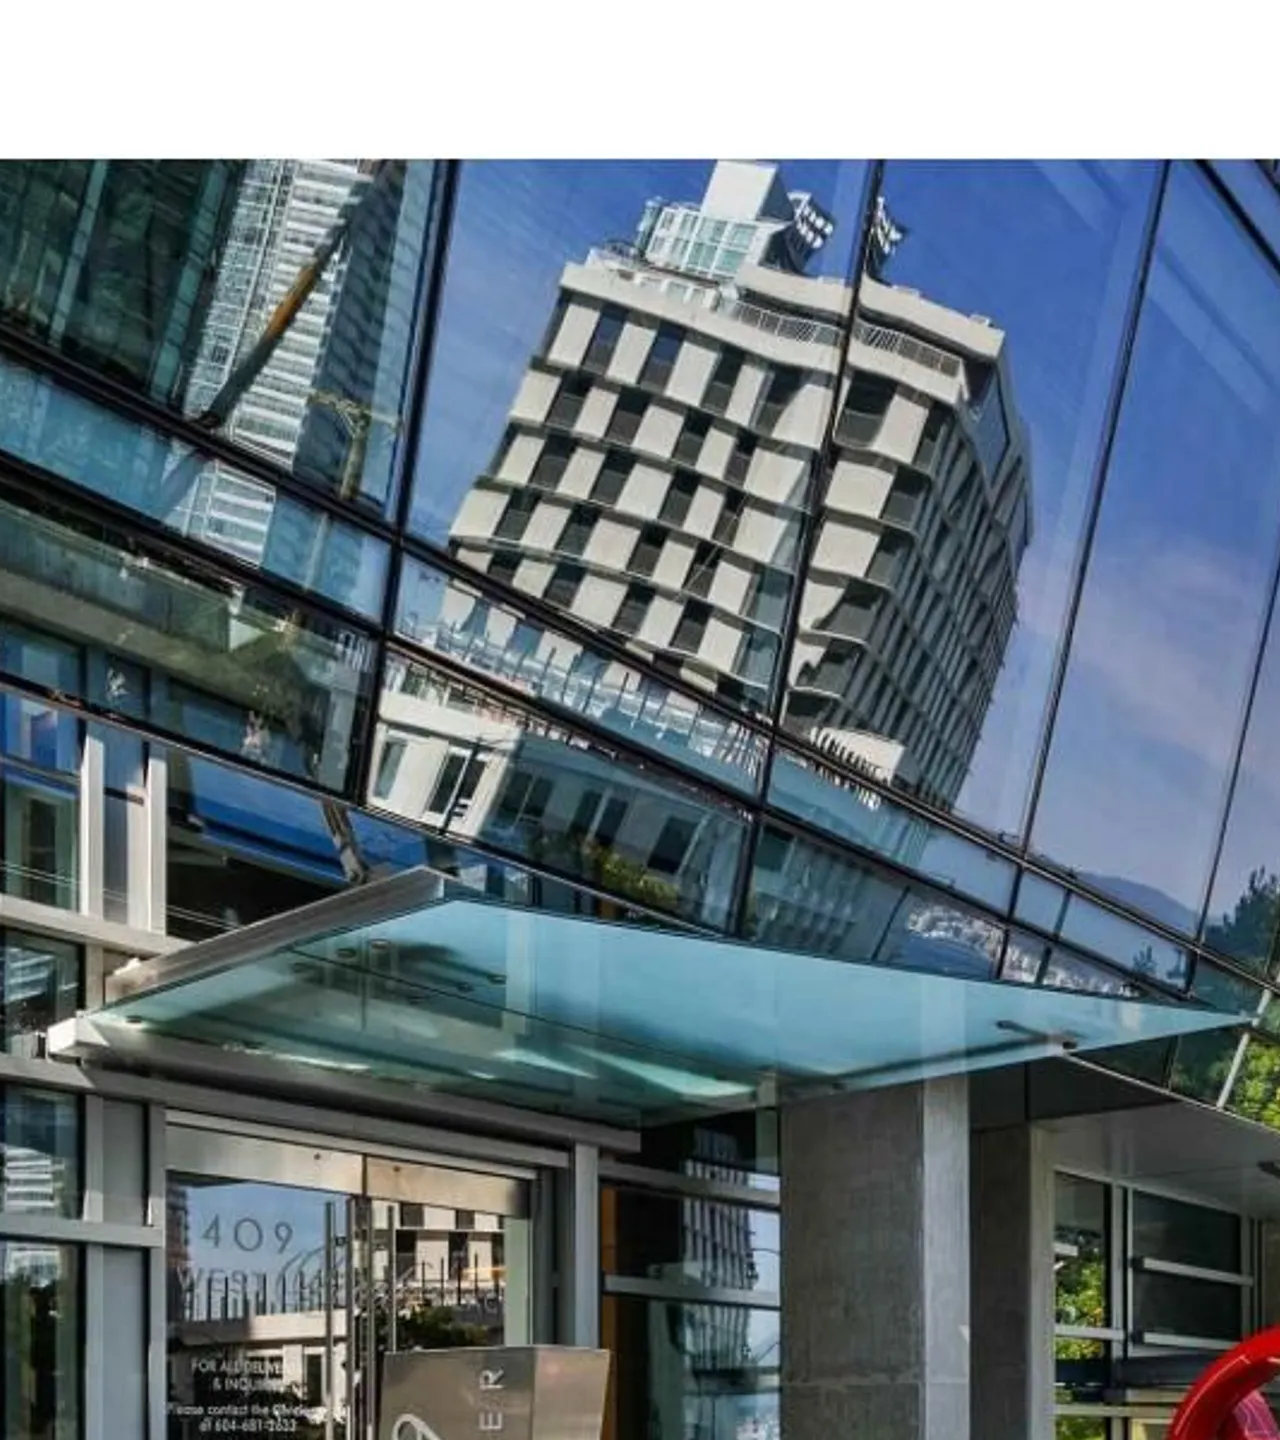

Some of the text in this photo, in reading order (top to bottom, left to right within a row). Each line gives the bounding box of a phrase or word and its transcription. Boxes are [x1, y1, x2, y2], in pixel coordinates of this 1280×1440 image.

[192, 1358, 216, 1373] FOR
[221, 1359, 241, 1373] ALL
[208, 1404, 247, 1415] contact
[251, 1403, 269, 1415] the
[199, 1417, 211, 1432] at
